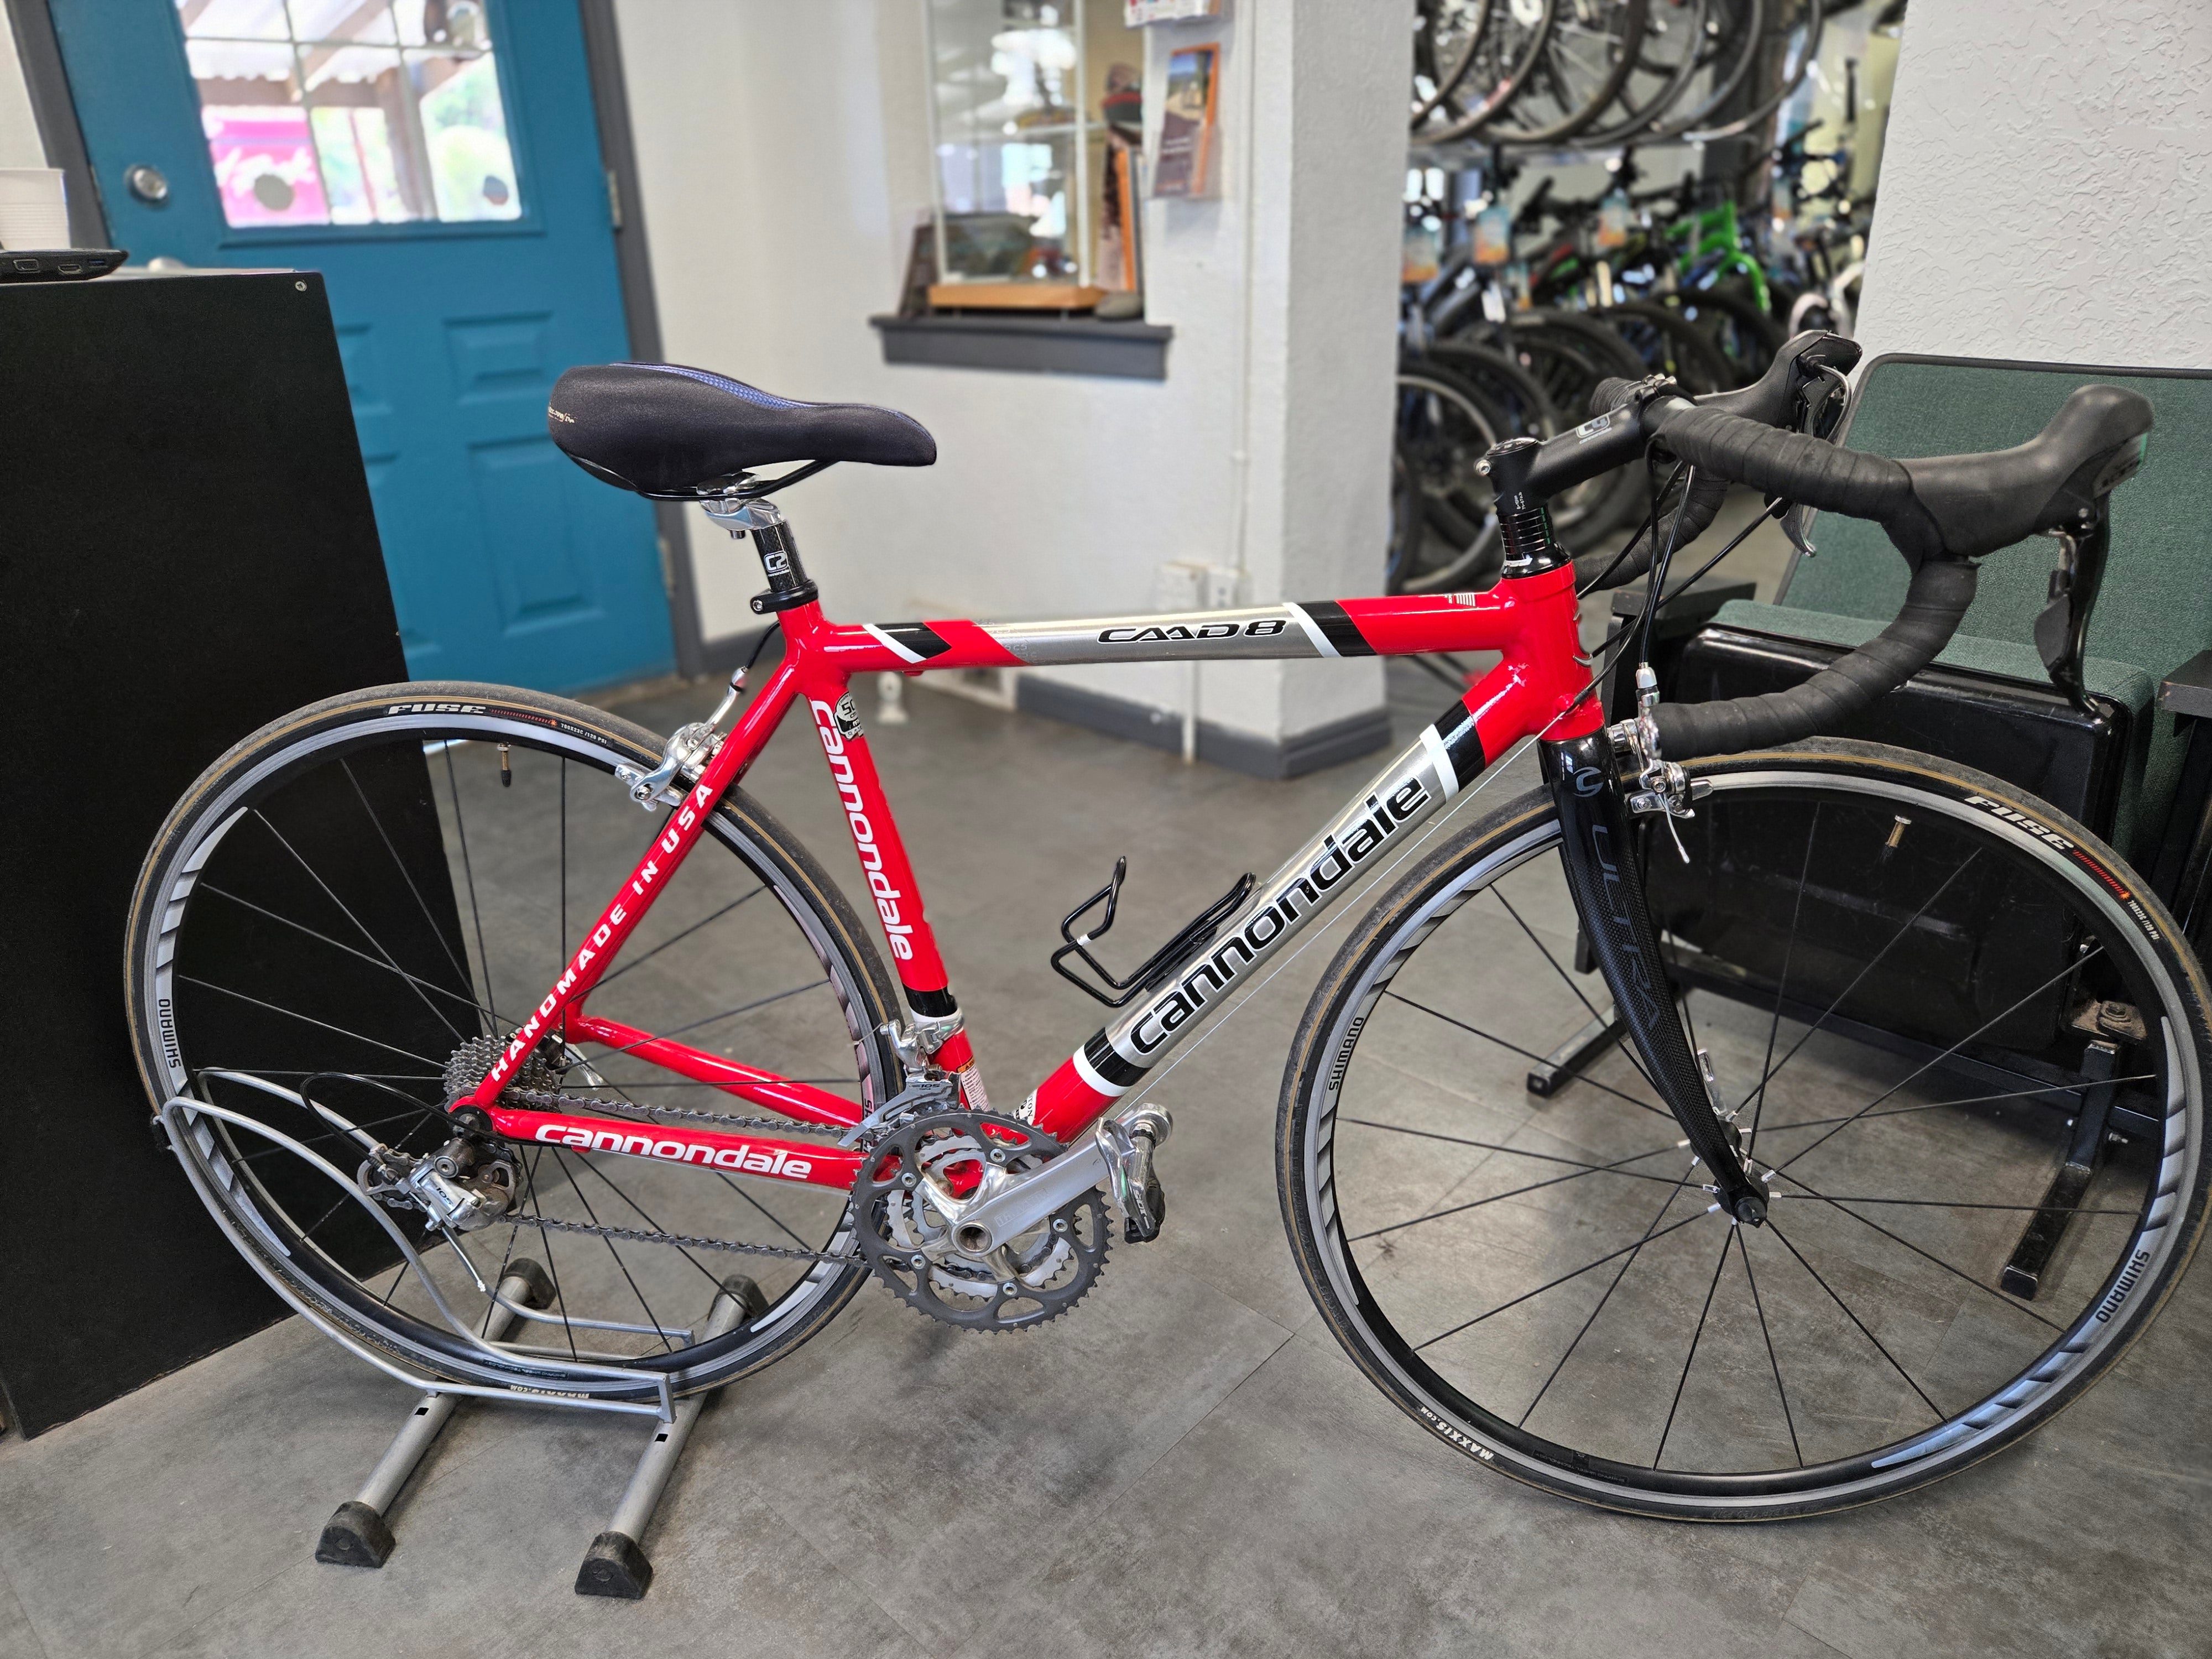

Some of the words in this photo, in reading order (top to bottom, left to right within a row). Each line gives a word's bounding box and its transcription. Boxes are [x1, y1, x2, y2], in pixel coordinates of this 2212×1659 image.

[765, 553, 786, 570] C2
[388, 703, 487, 714] FUSE
[561, 723, 583, 734] 700X23C
[811, 701, 913, 960] cannondale
[1964, 796, 2074, 849] FUSE
[491, 907, 627, 1082] HANDMADE
[632, 860, 659, 895] IN
[661, 785, 713, 853] USA
[1130, 775, 1432, 1056] cannondale
[1592, 823, 1663, 1030] ULTRA
[158, 998, 181, 1069] SHIMANO
[1329, 1016, 1364, 1091] SHIMANO
[535, 1124, 812, 1178] cannondale
[436, 1187, 453, 1206] 105
[2095, 1249, 2150, 1324] SHIMANO
[1421, 1406, 1494, 1460] MAXXIS.COM
